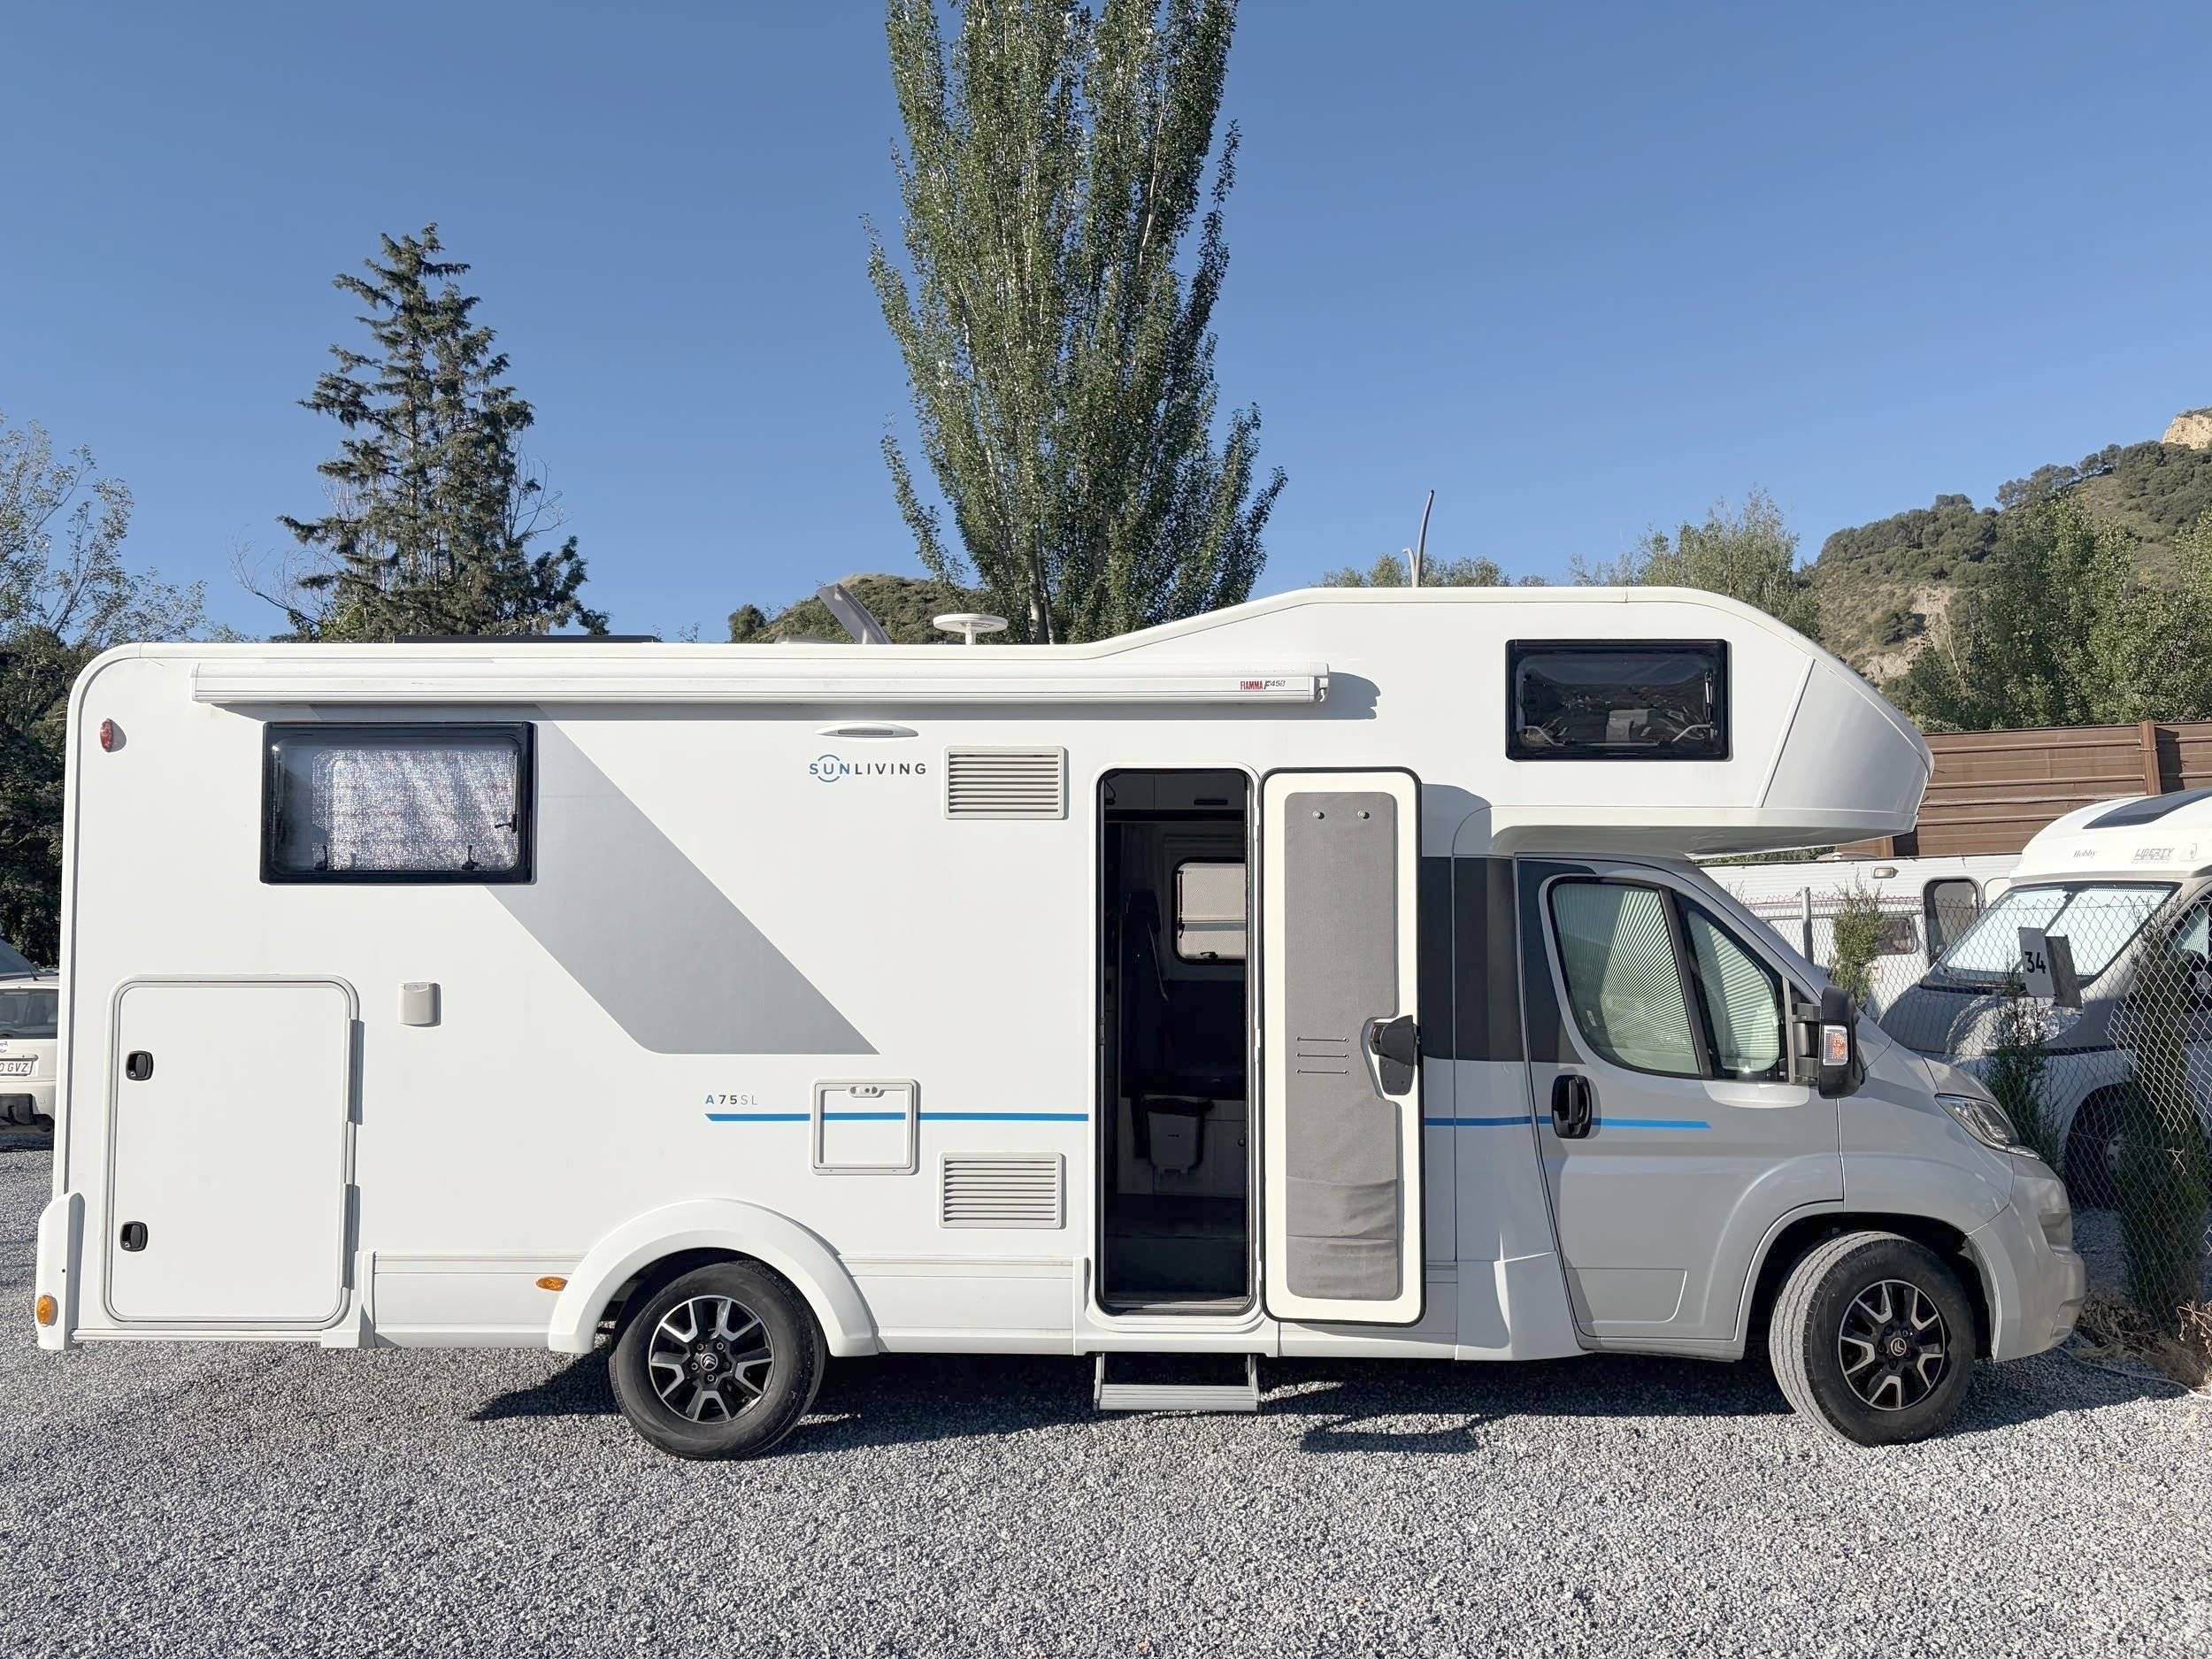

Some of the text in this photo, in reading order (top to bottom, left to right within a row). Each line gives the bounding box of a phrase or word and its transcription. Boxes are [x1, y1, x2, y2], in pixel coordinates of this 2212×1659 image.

[1240, 680, 1263, 690] FIAMMA
[809, 763, 926, 775] SUNLIVING
[2073, 849, 2097, 859] Hobby
[2024, 951, 2046, 974] 34
[7, 1063, 28, 1072] GVZ
